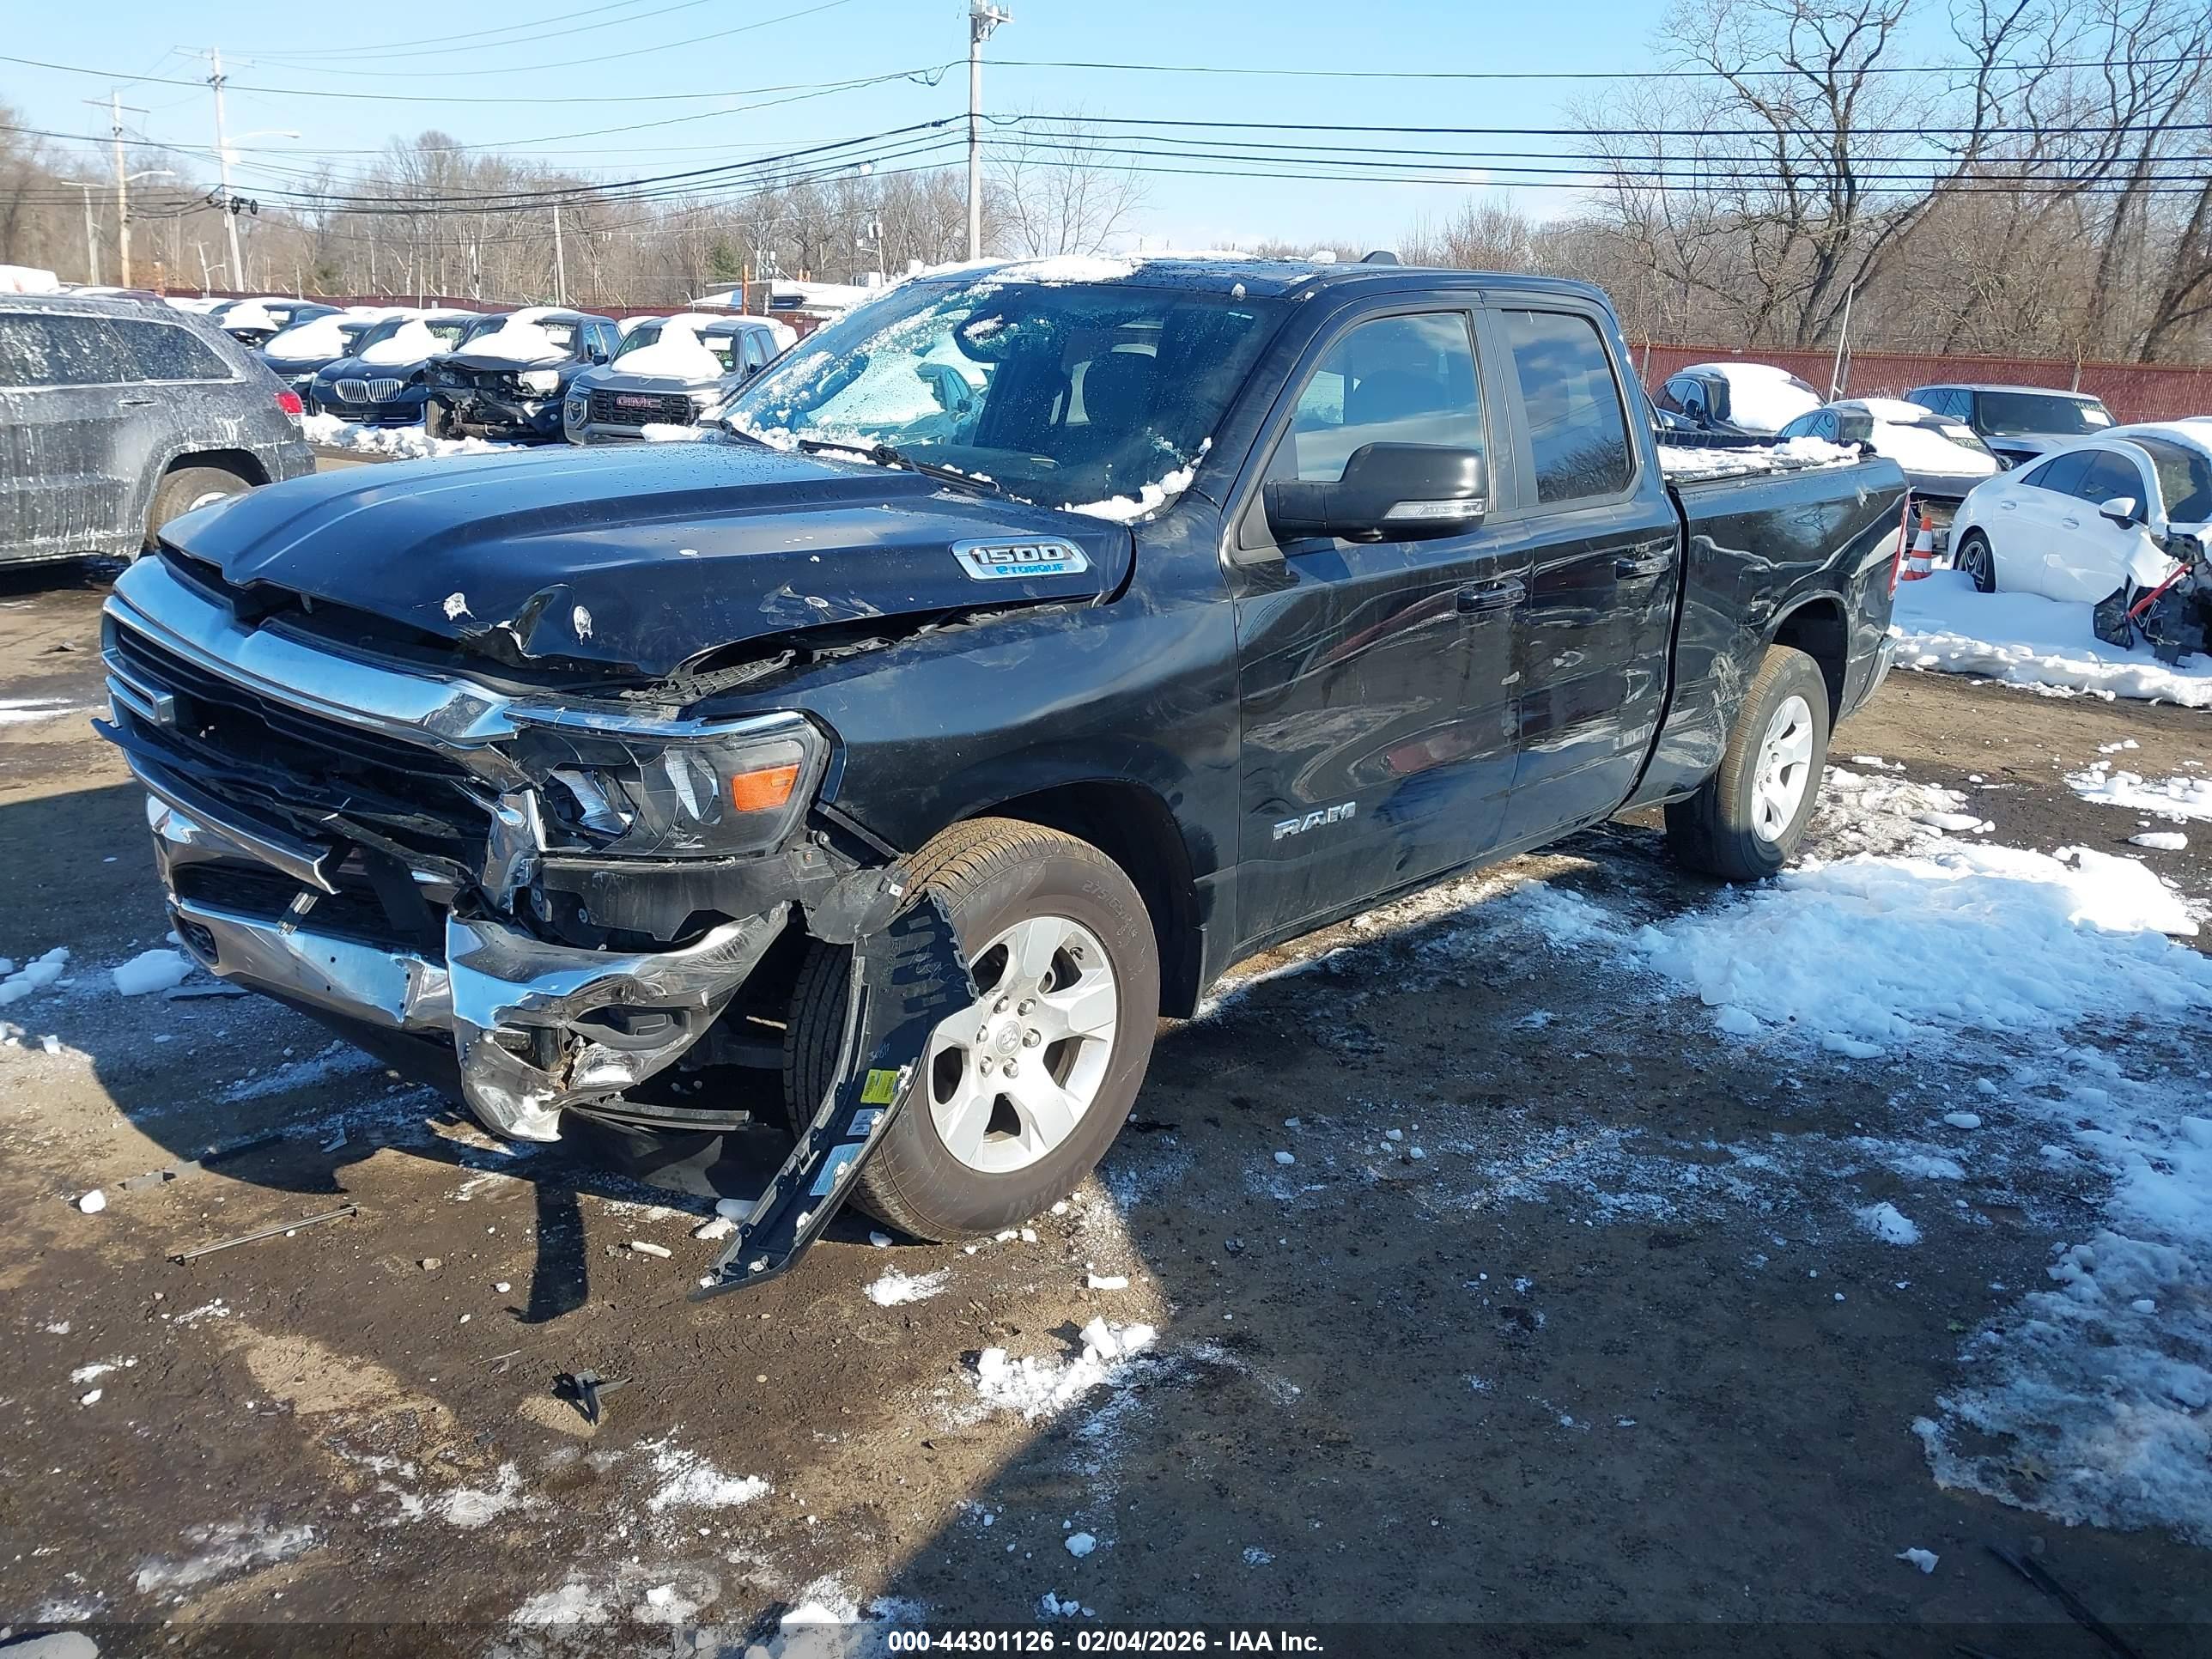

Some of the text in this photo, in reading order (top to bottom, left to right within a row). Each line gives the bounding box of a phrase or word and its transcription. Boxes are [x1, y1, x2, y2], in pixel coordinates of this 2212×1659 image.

[616, 395, 661, 408] GMC
[972, 545, 1065, 565] 1500
[1272, 801, 1356, 841] RAM
